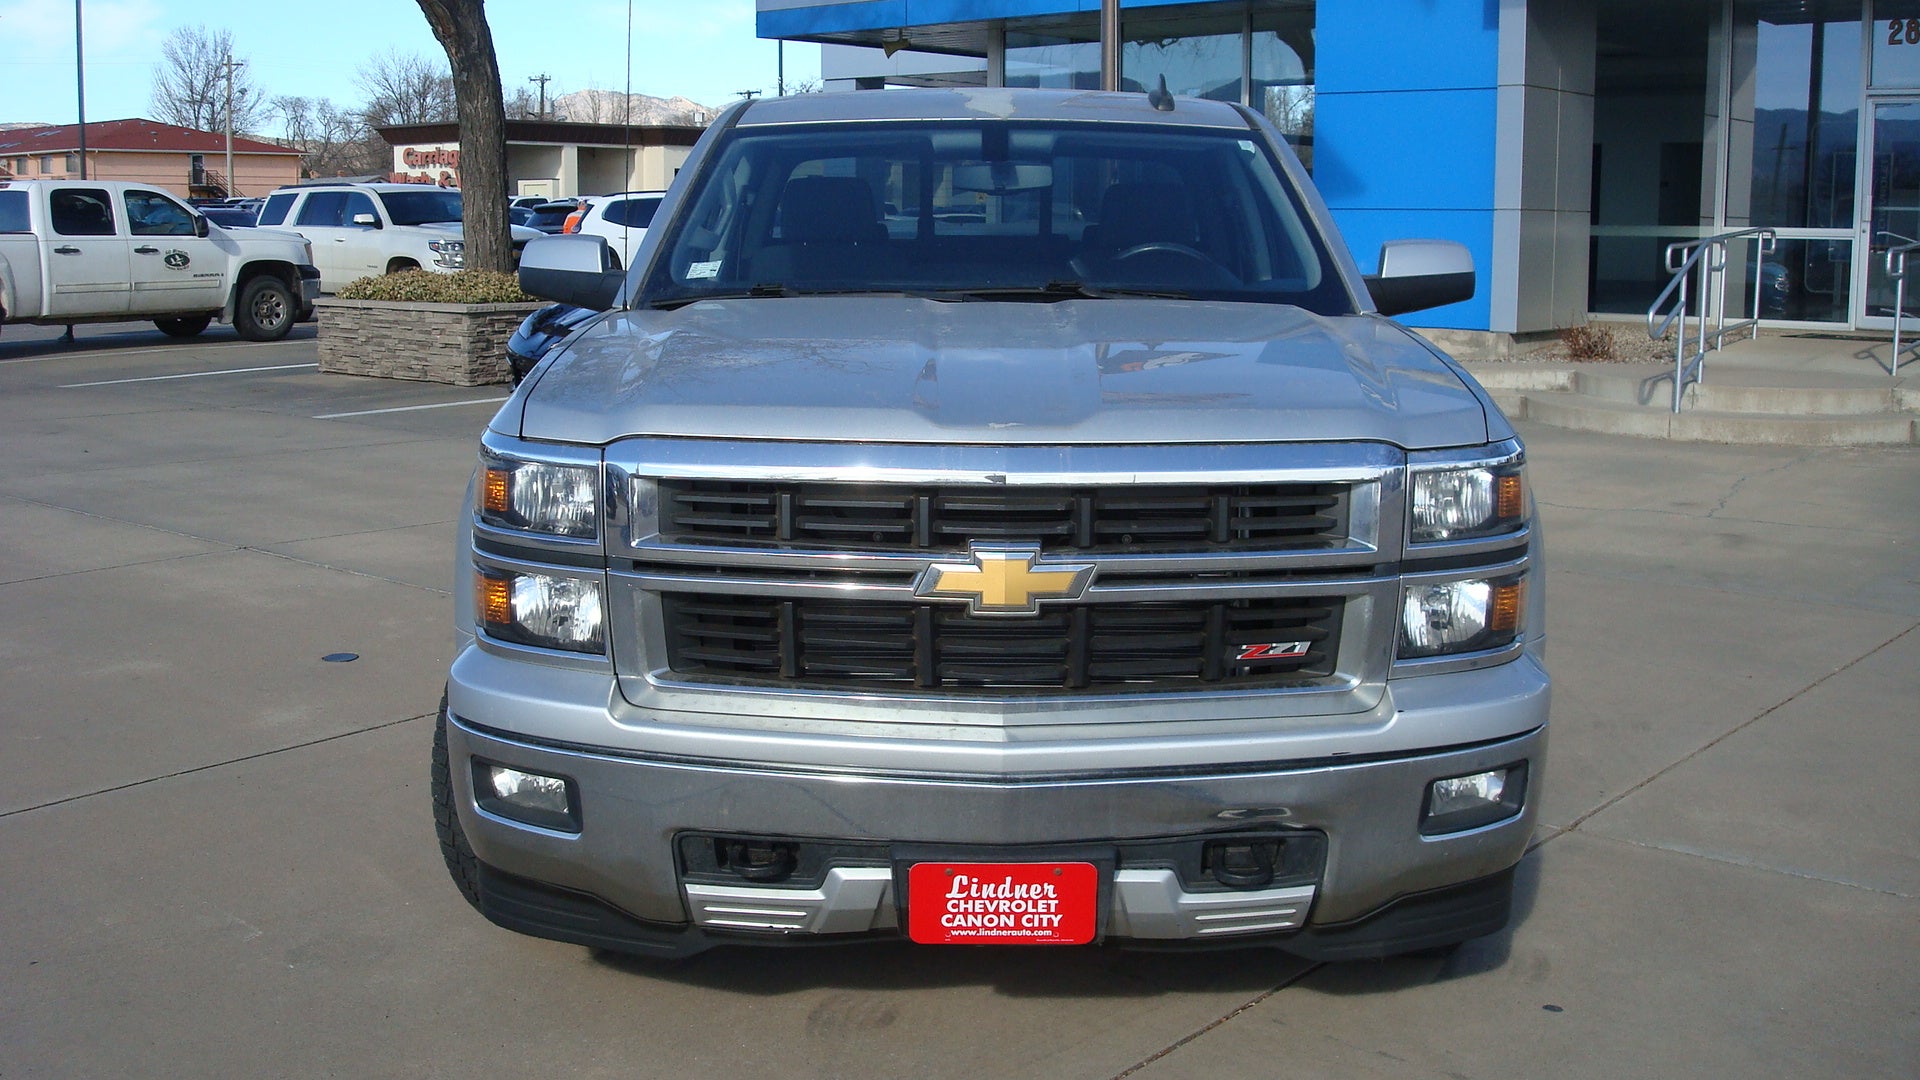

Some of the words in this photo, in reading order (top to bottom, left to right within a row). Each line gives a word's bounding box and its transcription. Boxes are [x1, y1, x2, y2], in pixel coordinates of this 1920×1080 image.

[1888, 18, 1920, 45] 28
[403, 147, 460, 169] Carriag
[1236, 641, 1312, 660] Z71
[945, 875, 1057, 899] Lindner
[946, 900, 1059, 913] CHEVROLET
[941, 914, 1015, 927] CANON
[1021, 914, 1063, 927] CITY
[950, 927, 1053, 937] www.lindnerauto.com
